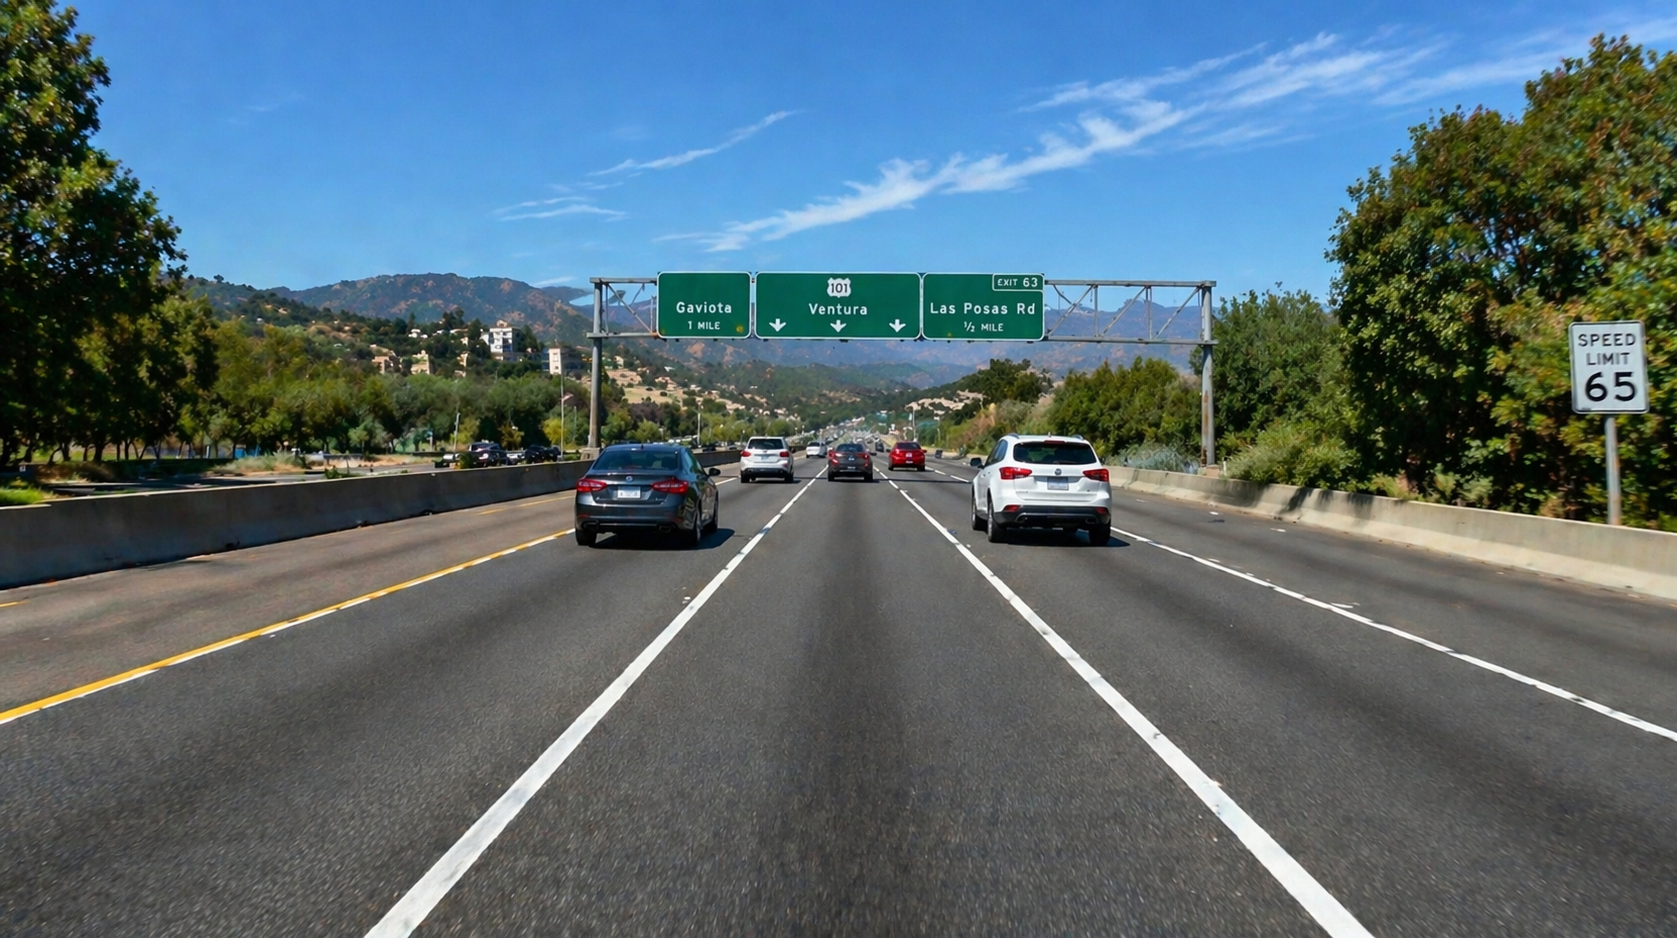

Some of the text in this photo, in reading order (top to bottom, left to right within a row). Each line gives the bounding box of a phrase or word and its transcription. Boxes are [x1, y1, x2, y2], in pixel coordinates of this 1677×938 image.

[830, 283, 849, 294] 101
[998, 277, 1038, 288] EXIT 63
[676, 301, 732, 314] Gaviota
[808, 303, 868, 315] Ventura
[930, 302, 1035, 315] Las Posas Rd
[687, 321, 721, 330] 1 MILE
[981, 323, 1004, 332] MILE
[1578, 333, 1636, 347] SPEED
[1586, 352, 1630, 366] LIMIT
[1585, 371, 1637, 402] 65
